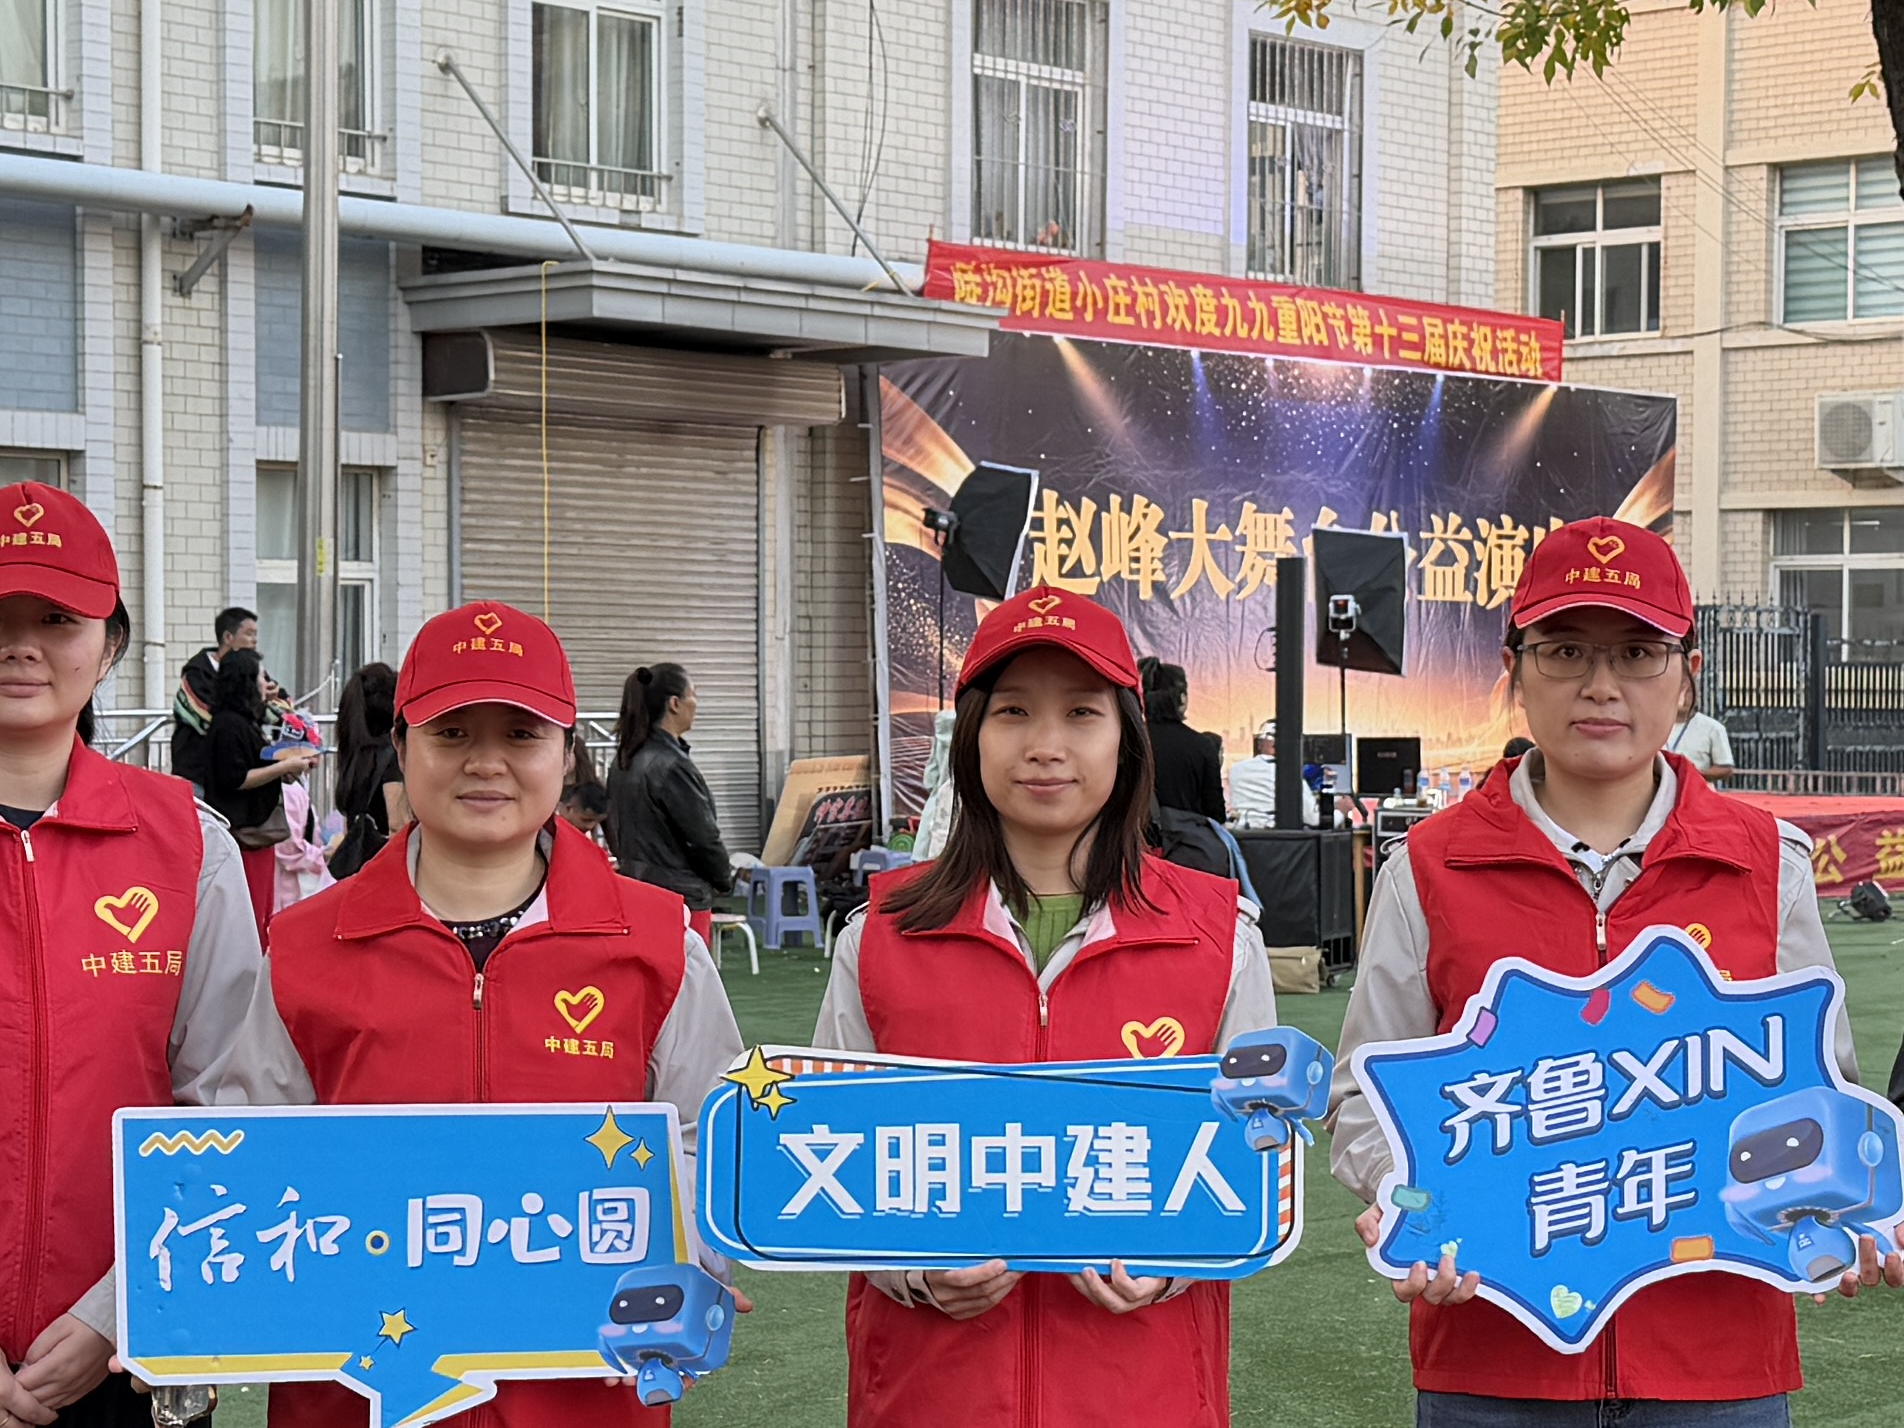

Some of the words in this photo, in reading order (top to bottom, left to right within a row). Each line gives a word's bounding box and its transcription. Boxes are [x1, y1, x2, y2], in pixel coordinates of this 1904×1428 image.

[1028, 488, 1565, 610] 赵峰大舞益演
[1565, 566, 1641, 589] 中建五局
[1013, 615, 1076, 633] 中建五局
[452, 636, 525, 657] 中建五局
[81, 949, 183, 978] 中建五局
[544, 1035, 614, 1059] 中建五局
[1441, 1014, 1786, 1165] 齐鲁XIN
[777, 1121, 1247, 1219] 文明中建人
[1530, 1138, 1699, 1258] 青年
